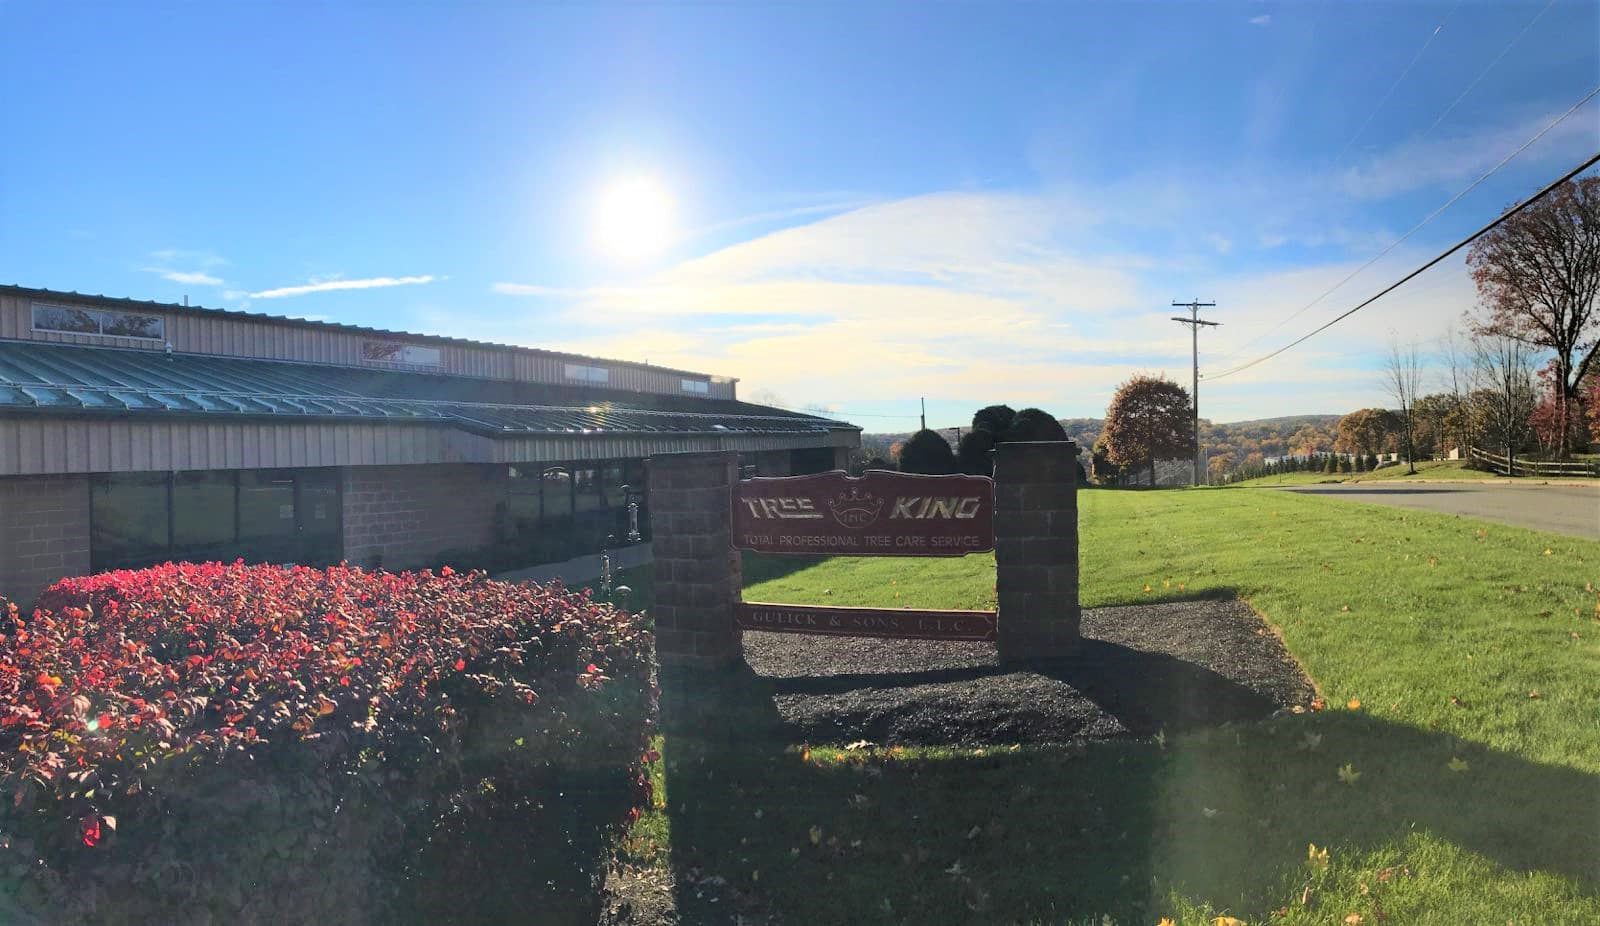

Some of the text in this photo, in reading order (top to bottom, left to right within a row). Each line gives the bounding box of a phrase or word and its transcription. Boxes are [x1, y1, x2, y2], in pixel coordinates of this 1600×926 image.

[741, 495, 981, 521] TREE KING
[743, 534, 980, 547] TOTAL PROFESSIONAL TREE CARE SERVICE
[752, 610, 817, 625] GULICK
[829, 615, 841, 626] &
